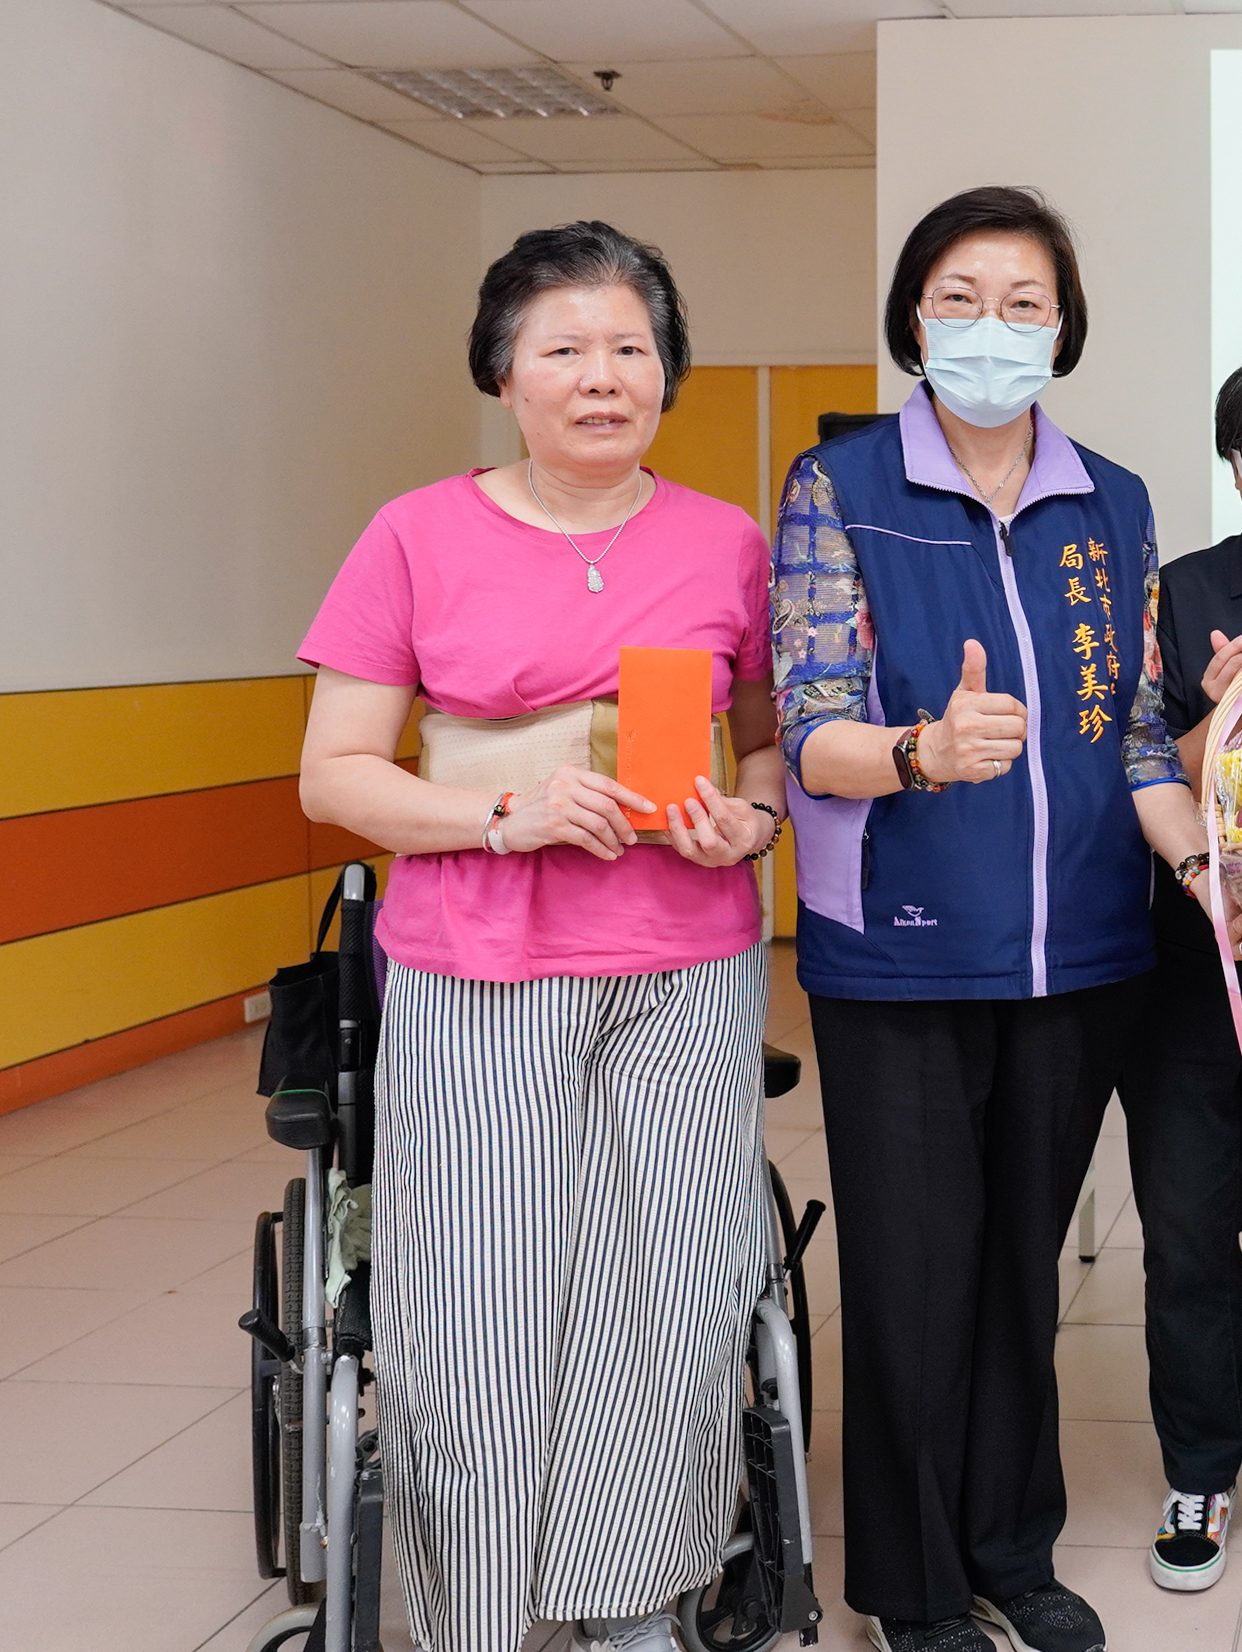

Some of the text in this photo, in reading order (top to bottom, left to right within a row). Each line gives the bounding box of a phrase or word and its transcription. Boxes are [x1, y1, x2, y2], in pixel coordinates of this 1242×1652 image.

[1059, 543, 1113, 744] 局長 李美珍
